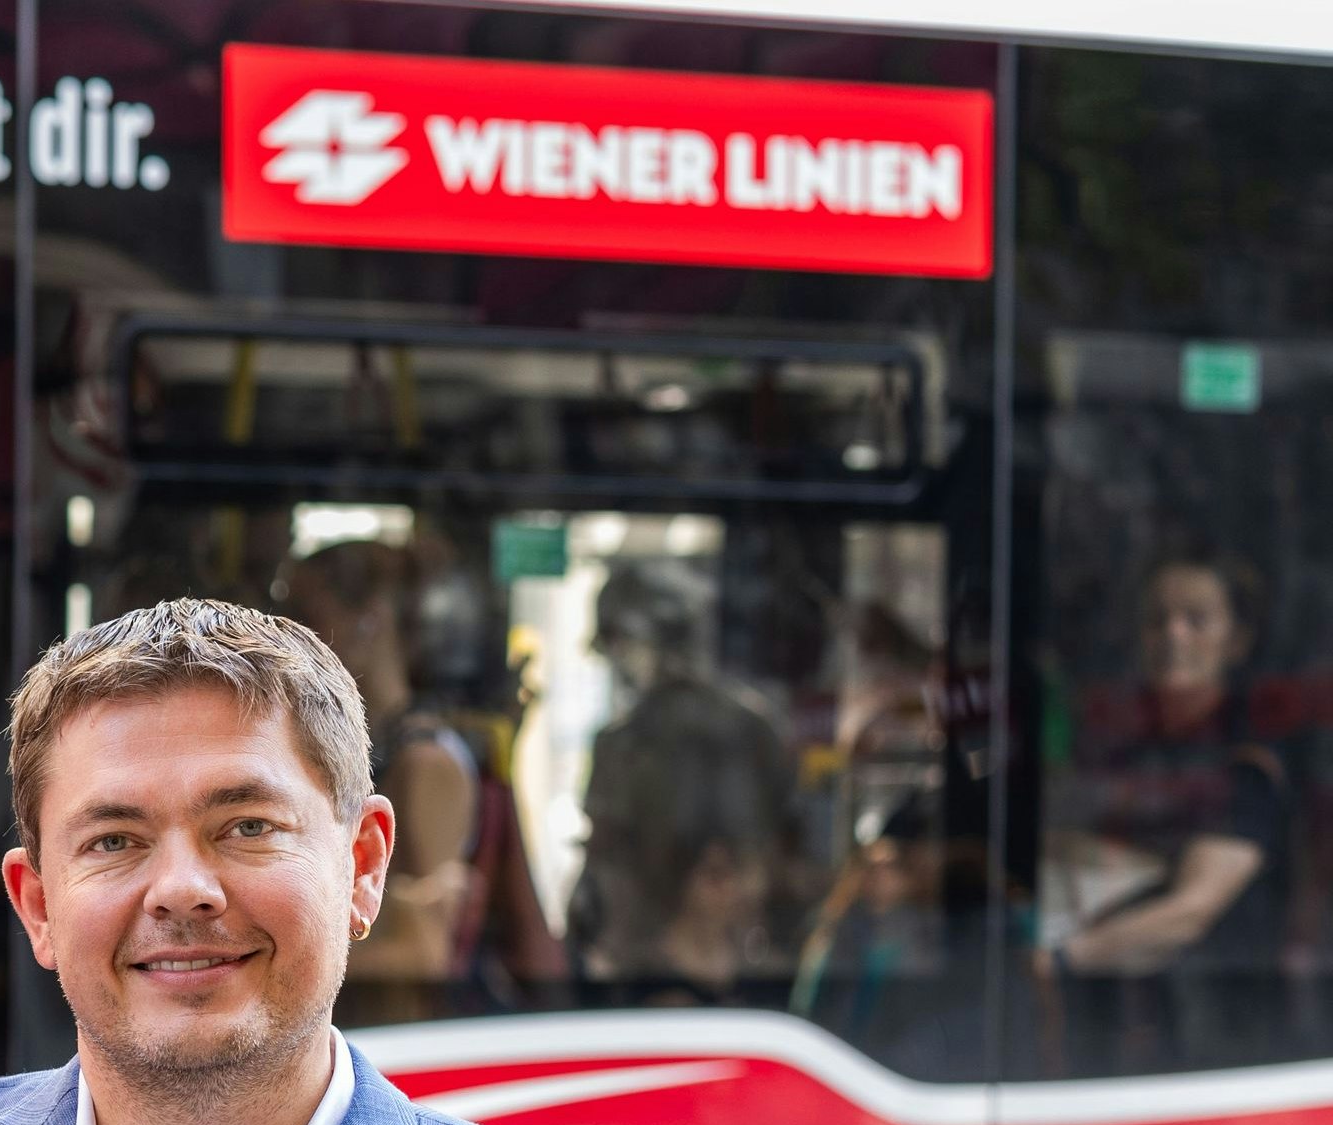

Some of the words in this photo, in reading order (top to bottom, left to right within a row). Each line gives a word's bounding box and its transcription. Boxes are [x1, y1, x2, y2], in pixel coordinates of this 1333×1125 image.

[29, 75, 171, 192] dir.
[425, 114, 719, 208] WIENER
[727, 131, 965, 222] LINIEN
